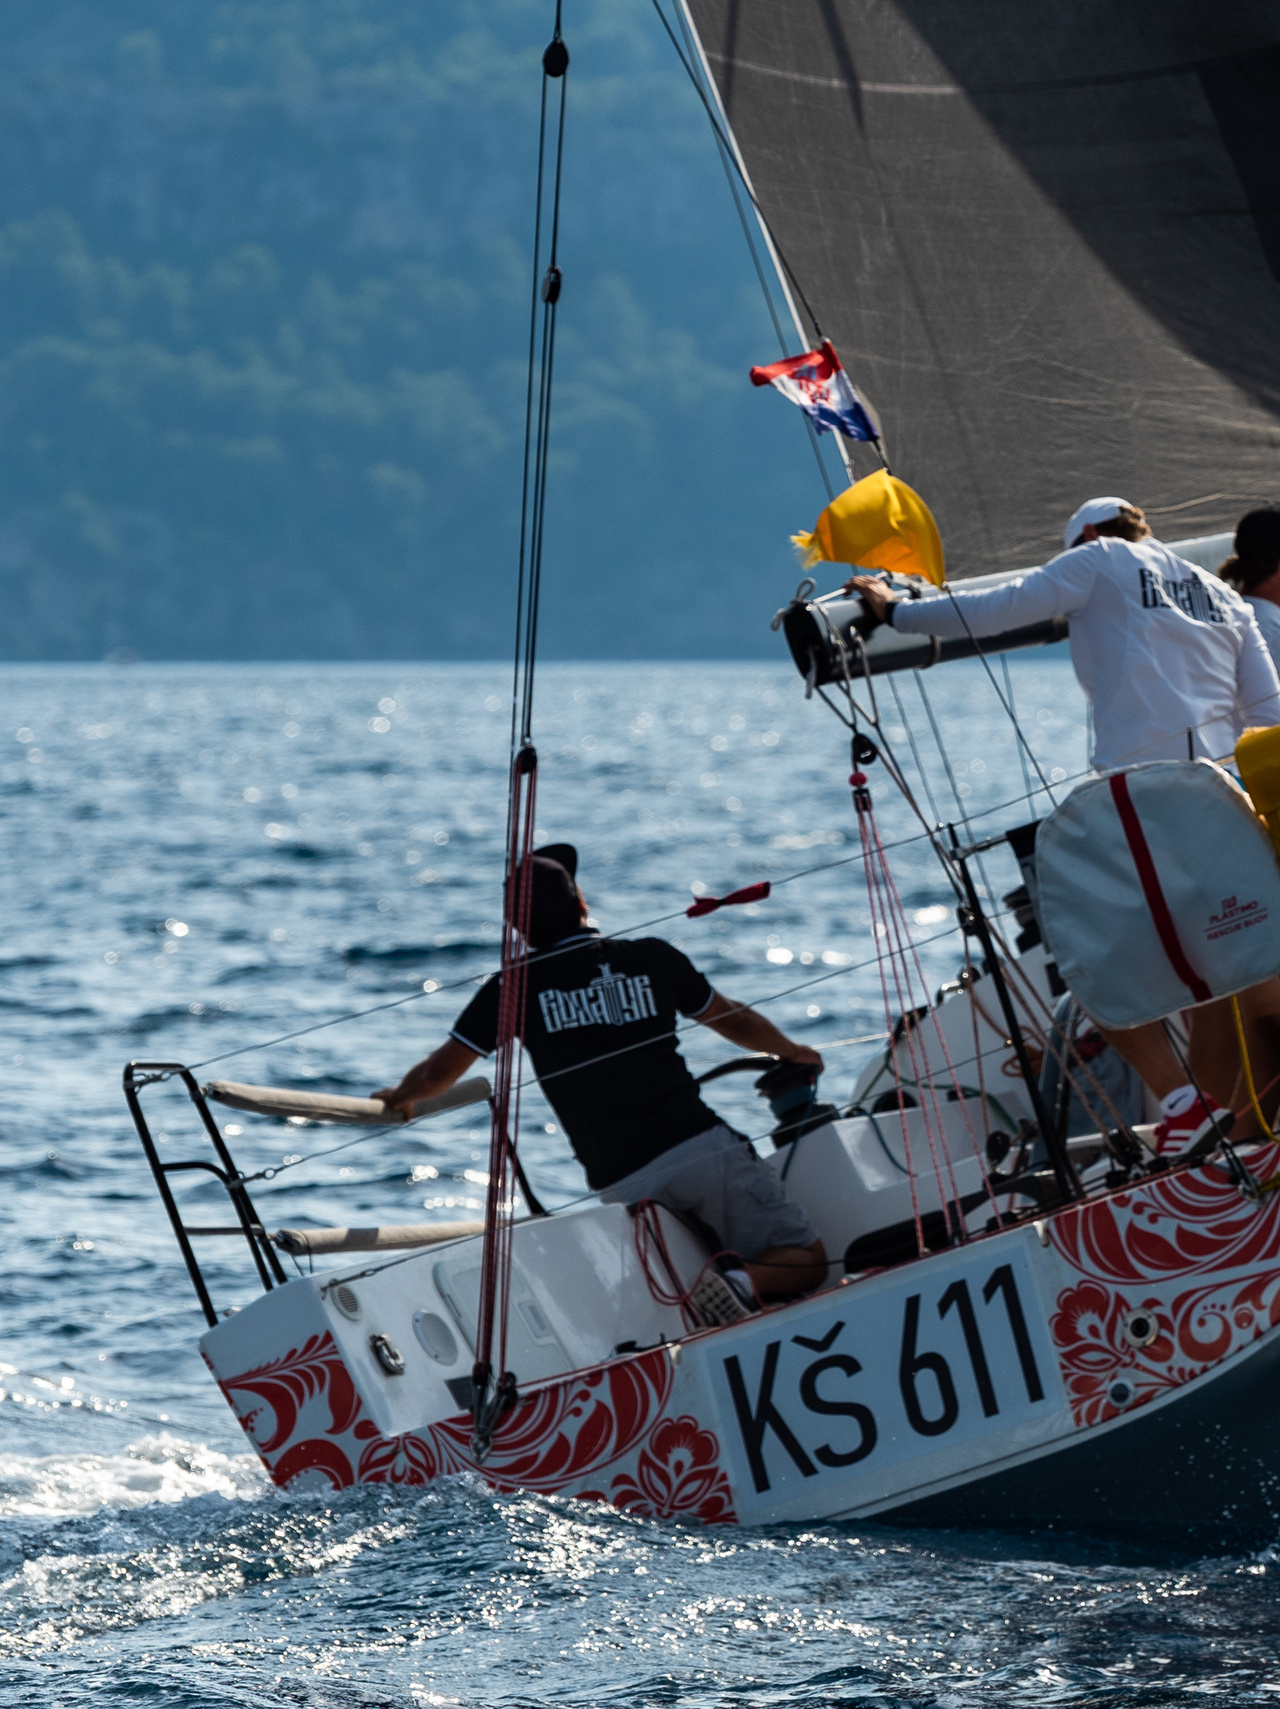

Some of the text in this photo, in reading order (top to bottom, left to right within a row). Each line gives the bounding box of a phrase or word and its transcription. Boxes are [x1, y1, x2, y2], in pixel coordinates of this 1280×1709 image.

[1206, 912, 1269, 941] RESCUE BUOY
[1208, 900, 1259, 925] PLASTIMO
[723, 1263, 1046, 1494] KŠ 611
